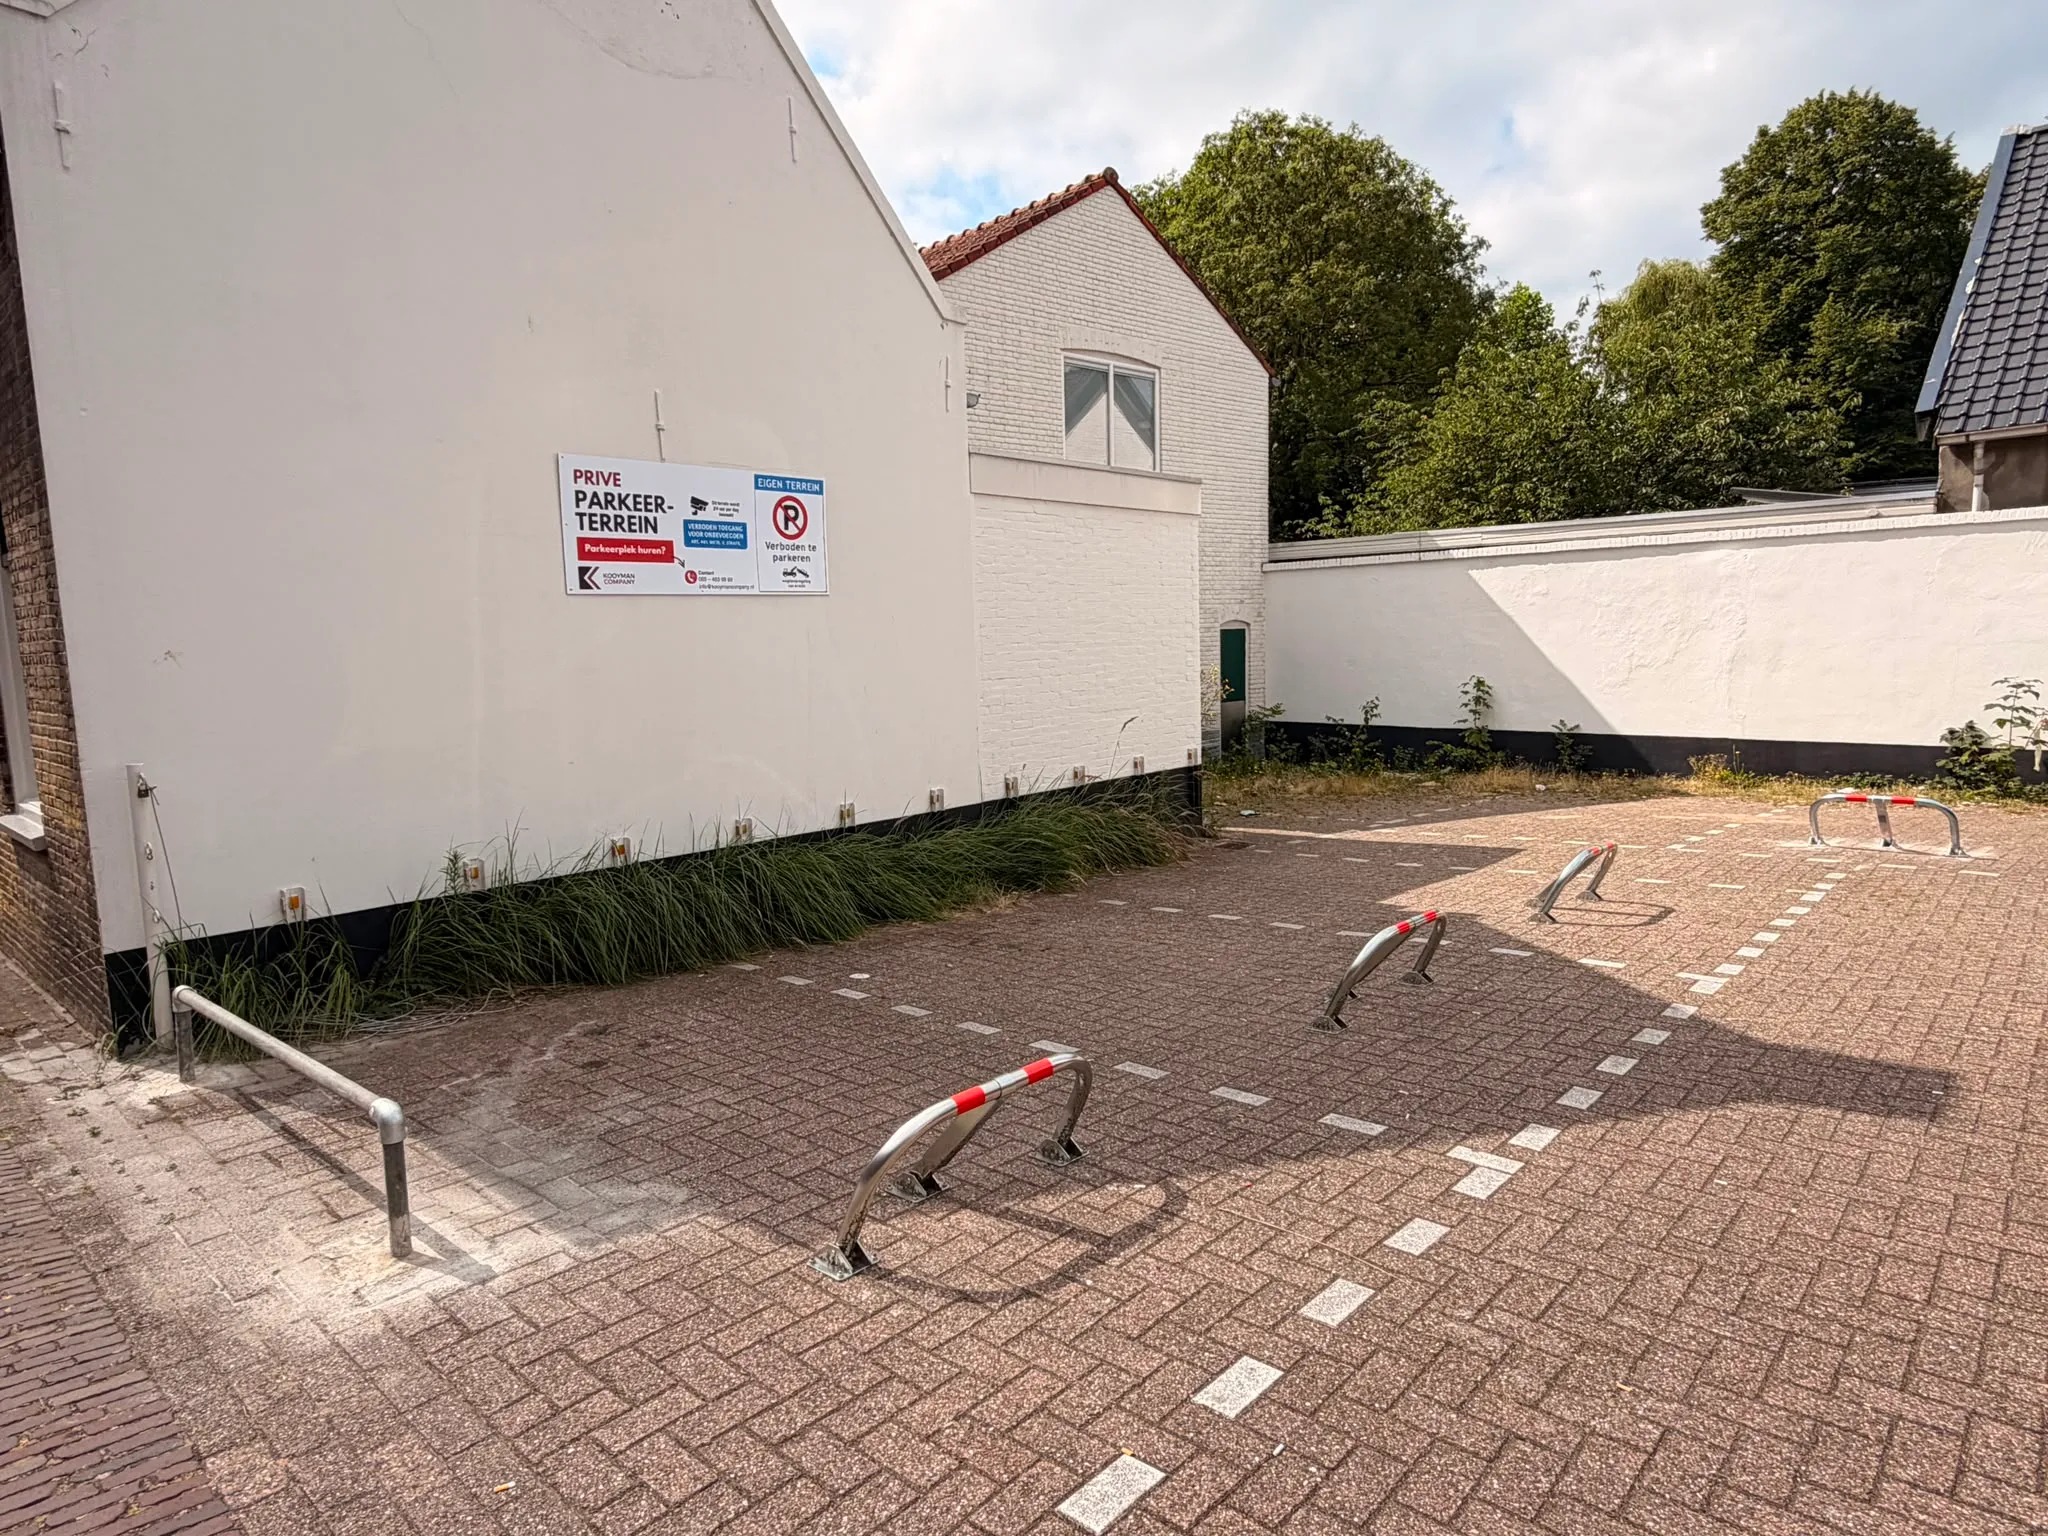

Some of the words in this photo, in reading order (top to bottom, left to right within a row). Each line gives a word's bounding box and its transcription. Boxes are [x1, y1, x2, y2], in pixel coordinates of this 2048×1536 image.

[573, 468, 622, 487] PRIVE
[757, 478, 783, 489] EIGEN
[785, 480, 821, 492] TERREIN
[574, 489, 674, 514] PARKEER-
[574, 512, 658, 534] TERREIN
[687, 523, 718, 531] VERBODEN
[718, 524, 743, 532] TOEGANG
[584, 543, 637, 556] Parkeerplek
[637, 544, 667, 555] huren?
[765, 541, 806, 552] Verboden
[807, 543, 817, 552] te
[772, 553, 811, 563] parkeren
